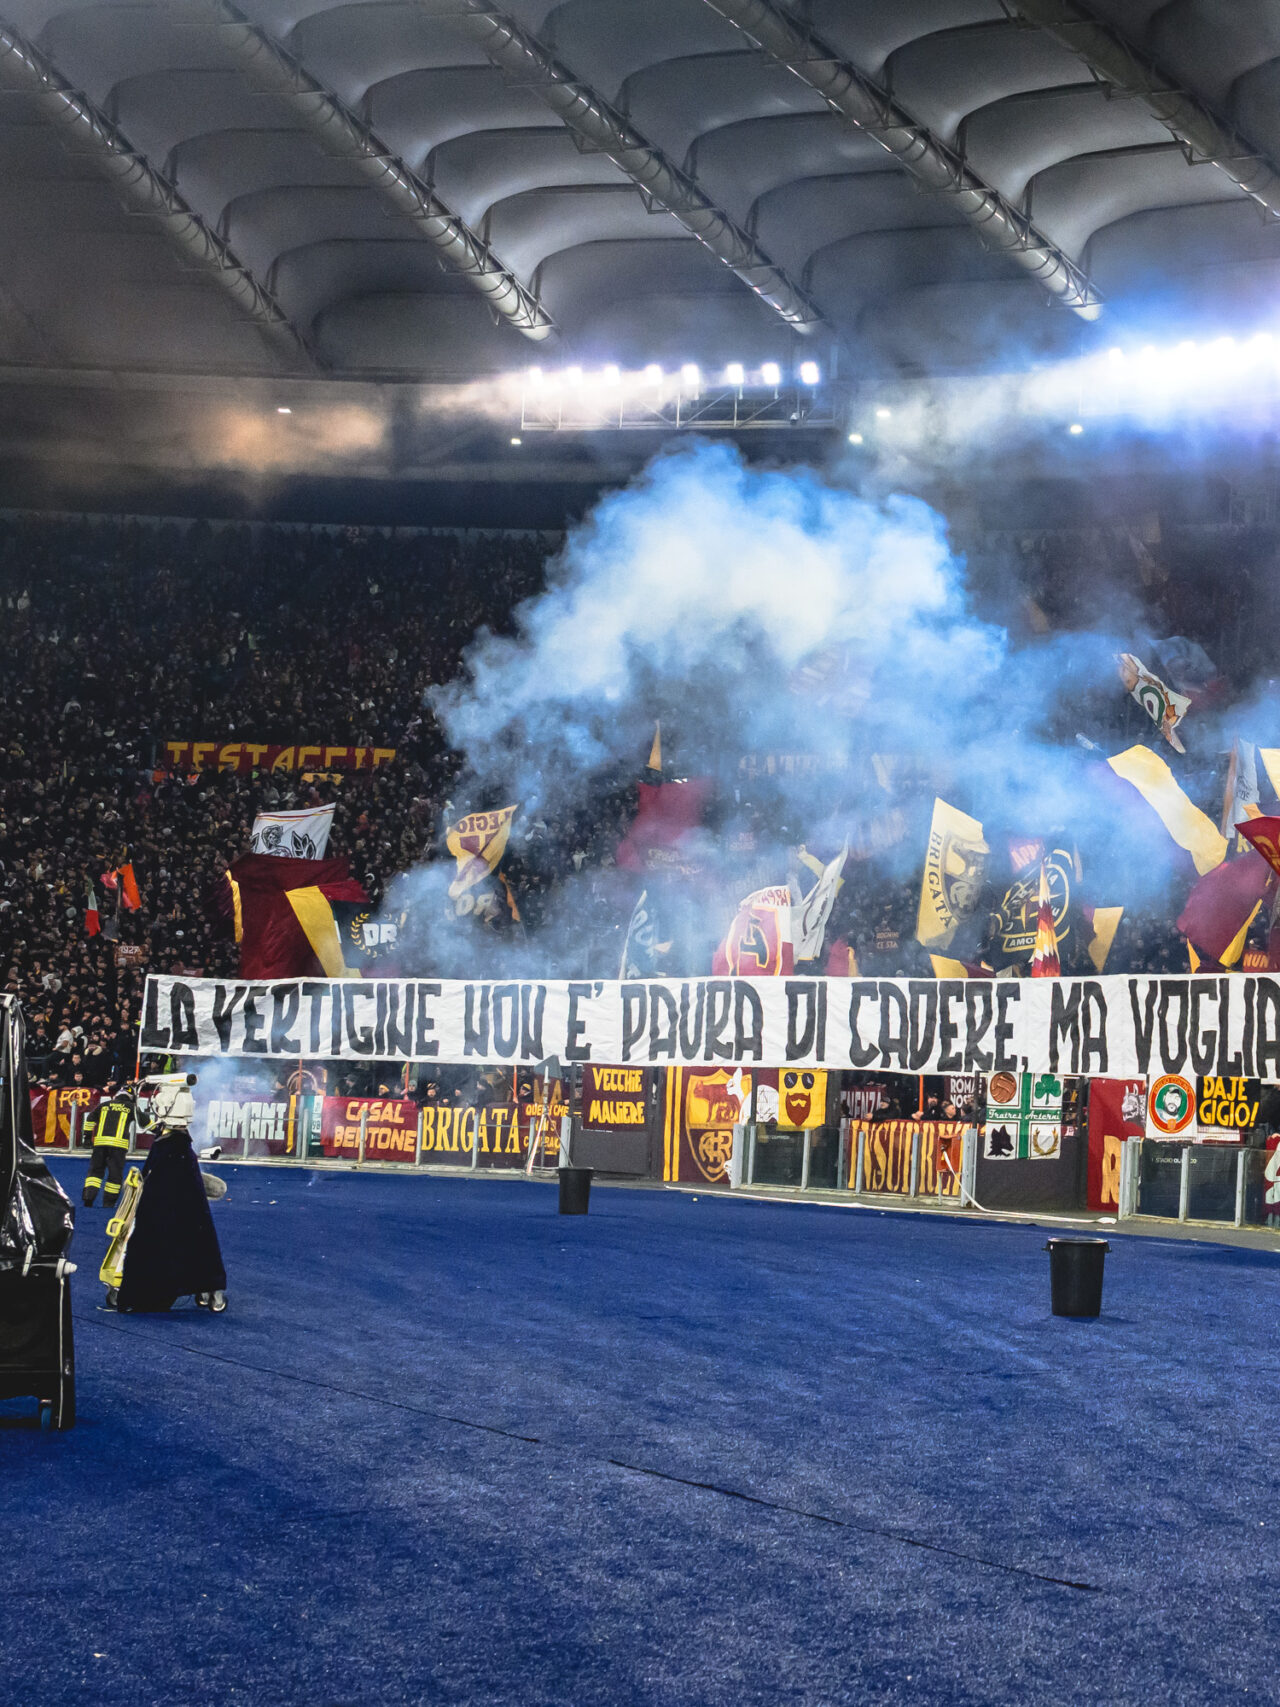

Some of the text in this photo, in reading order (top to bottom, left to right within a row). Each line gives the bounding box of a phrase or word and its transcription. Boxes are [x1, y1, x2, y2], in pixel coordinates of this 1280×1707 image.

[930, 831, 955, 928] BRIGATA
[140, 979, 199, 1050] LA
[213, 982, 442, 1057] VERTIGINE
[463, 984, 546, 1060] NON
[621, 980, 764, 1062] PAURA
[784, 980, 827, 1062] DI
[849, 981, 1028, 1073] CADERE,
[1048, 982, 1109, 1073] MA
[1203, 1076, 1249, 1102] DAJE
[207, 1100, 288, 1140] ROMANI
[346, 1101, 405, 1124] CASAL
[421, 1105, 521, 1153] BRIGATA
[988, 1108, 1061, 1121] Fratres Aeterni
[1198, 1099, 1260, 1128] GIGIO!
